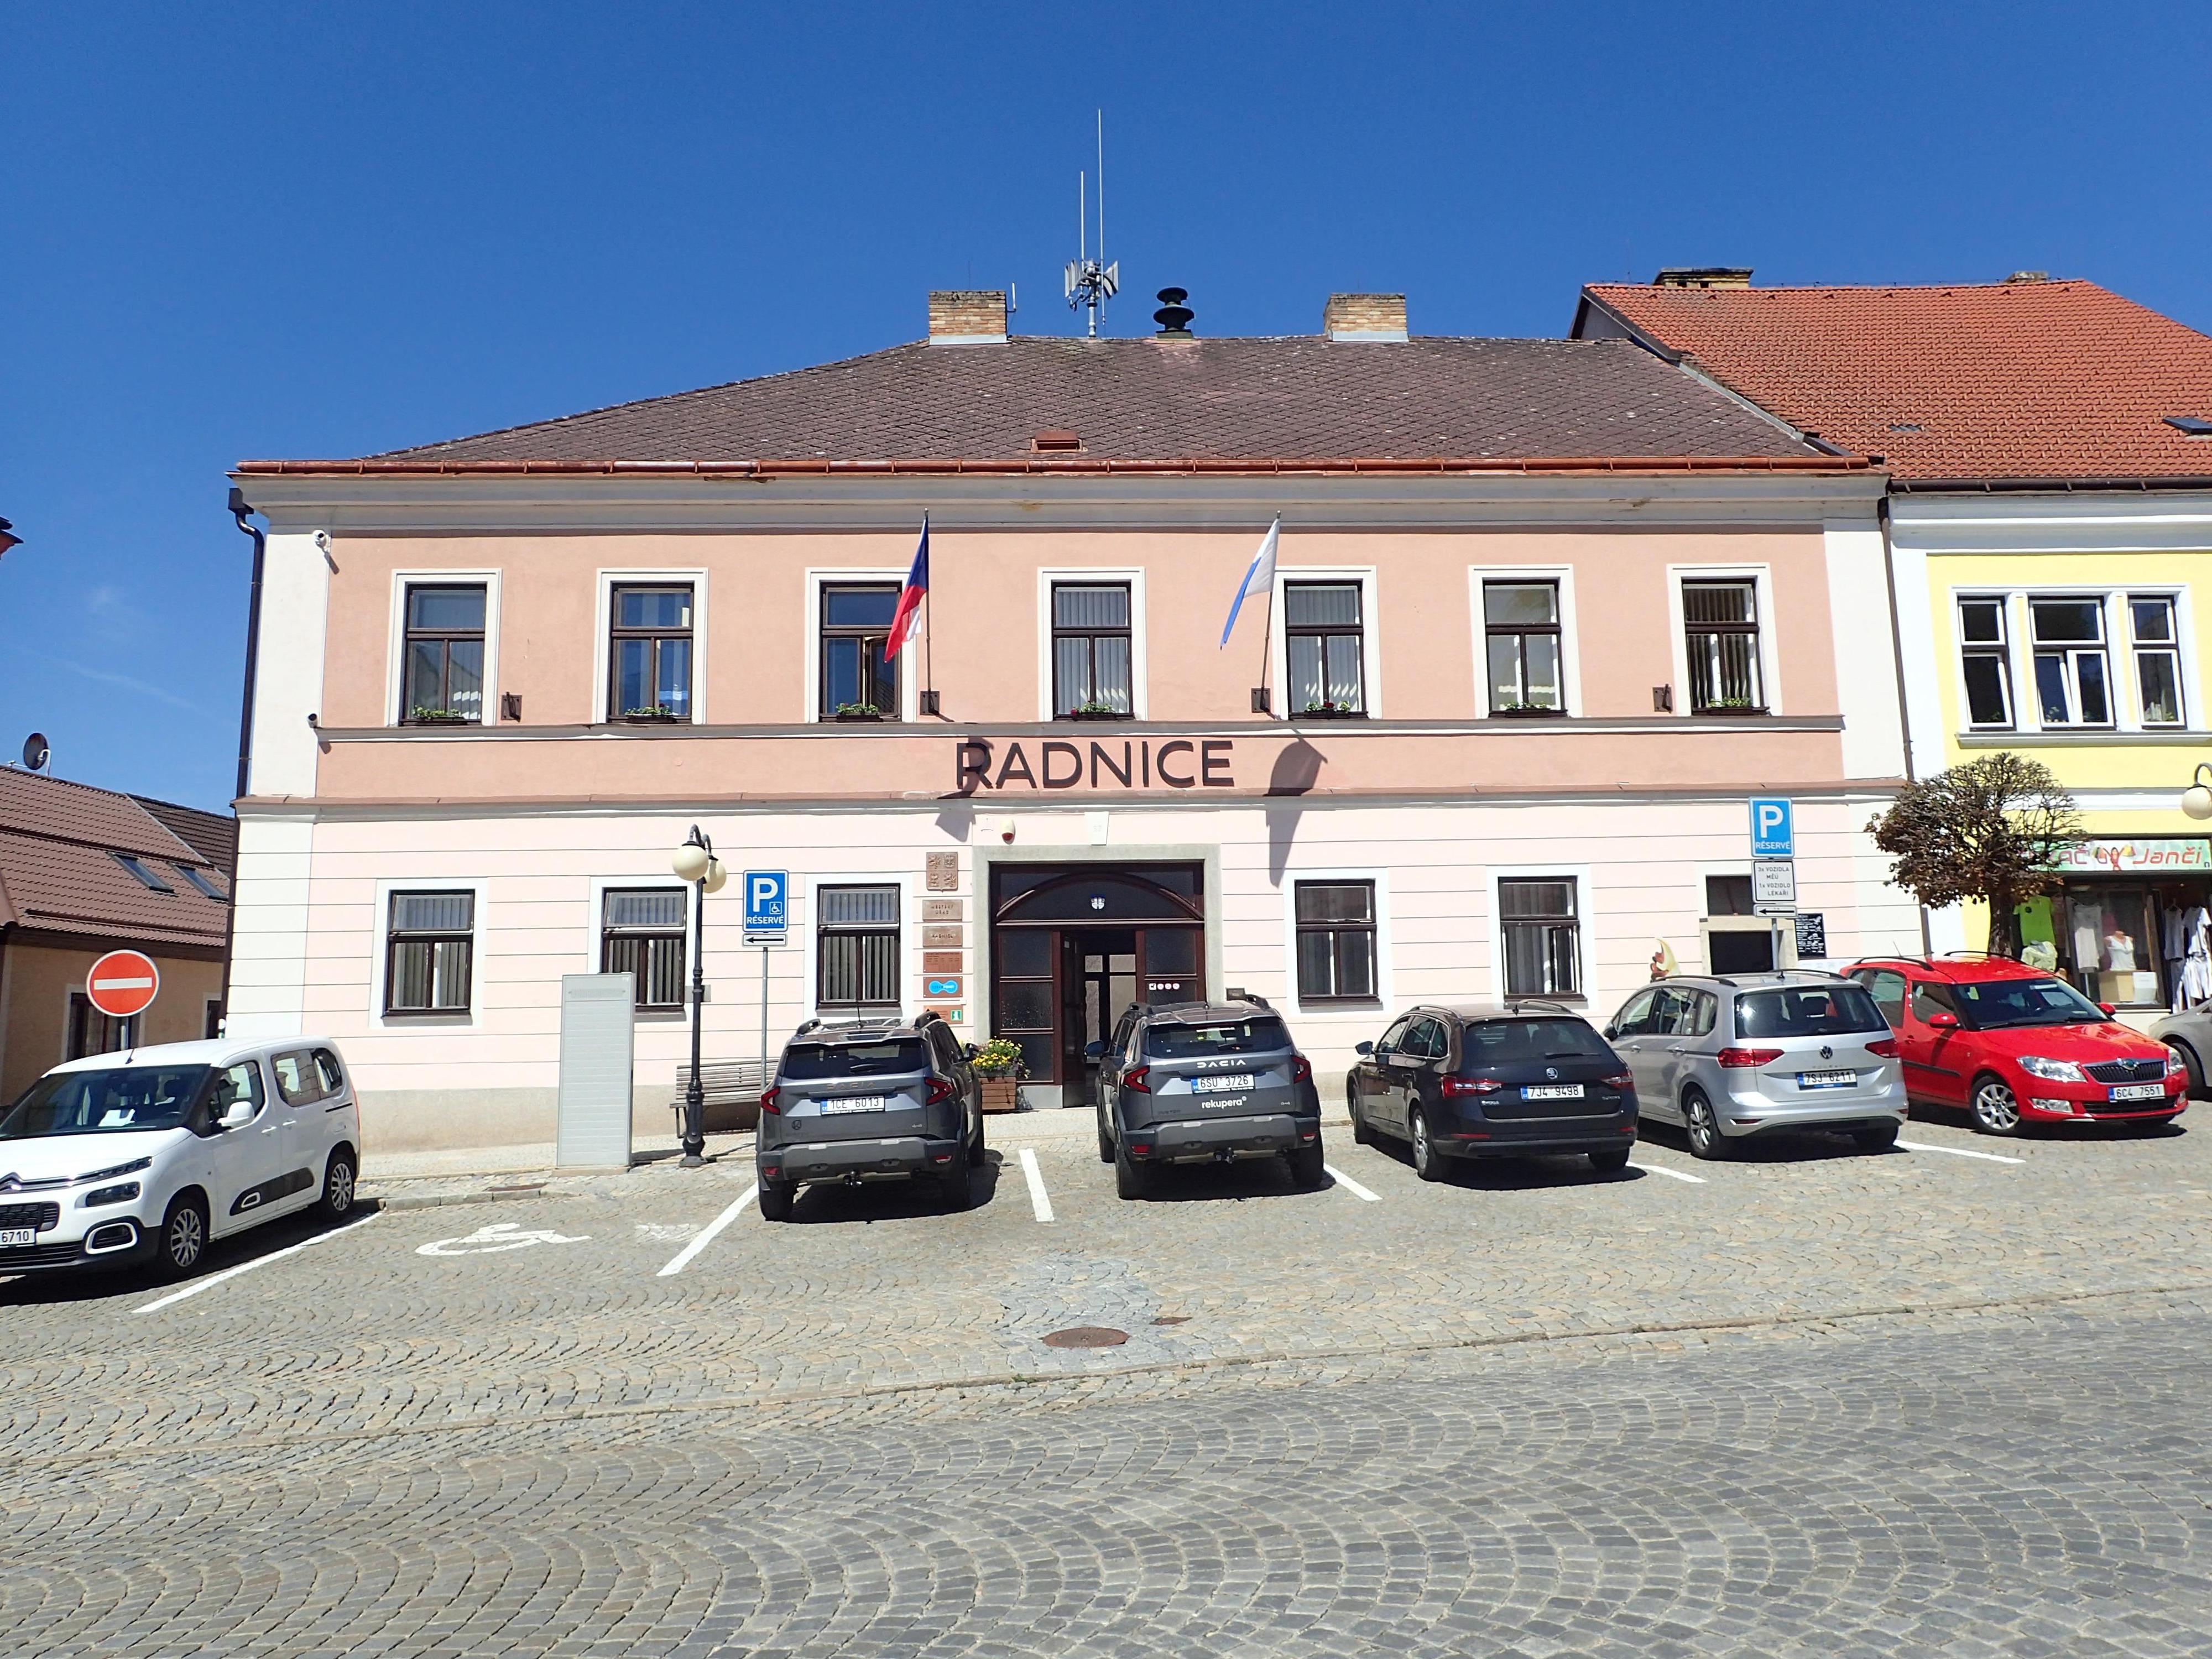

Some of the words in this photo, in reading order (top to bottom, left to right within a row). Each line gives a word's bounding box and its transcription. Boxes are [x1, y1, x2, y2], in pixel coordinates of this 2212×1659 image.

[956, 740, 1235, 789] RADNICE
[1759, 805, 1783, 838] P
[1756, 839, 1791, 850] RÉSERVÉ
[2133, 846, 2202, 864] Janči
[753, 878, 778, 912] P
[747, 915, 784, 924] RÉSERVÉ
[1197, 1060, 1246, 1068] DACIA
[1201, 1078, 1218, 1088] 6SU
[1225, 1076, 1249, 1086] 3726
[1806, 1073, 1822, 1083] 7SJ
[1829, 1072, 1851, 1081] 6211
[1529, 1087, 1547, 1097] 7J4
[1556, 1086, 1578, 1095] 9498
[2116, 1088, 2133, 1098] 6C4
[2140, 1086, 2159, 1095] 7551
[831, 1099, 847, 1109] 1CE
[855, 1097, 879, 1108] 6013
[1202, 1099, 1243, 1109] rekupera
[2, 1230, 29, 1243] 6710
